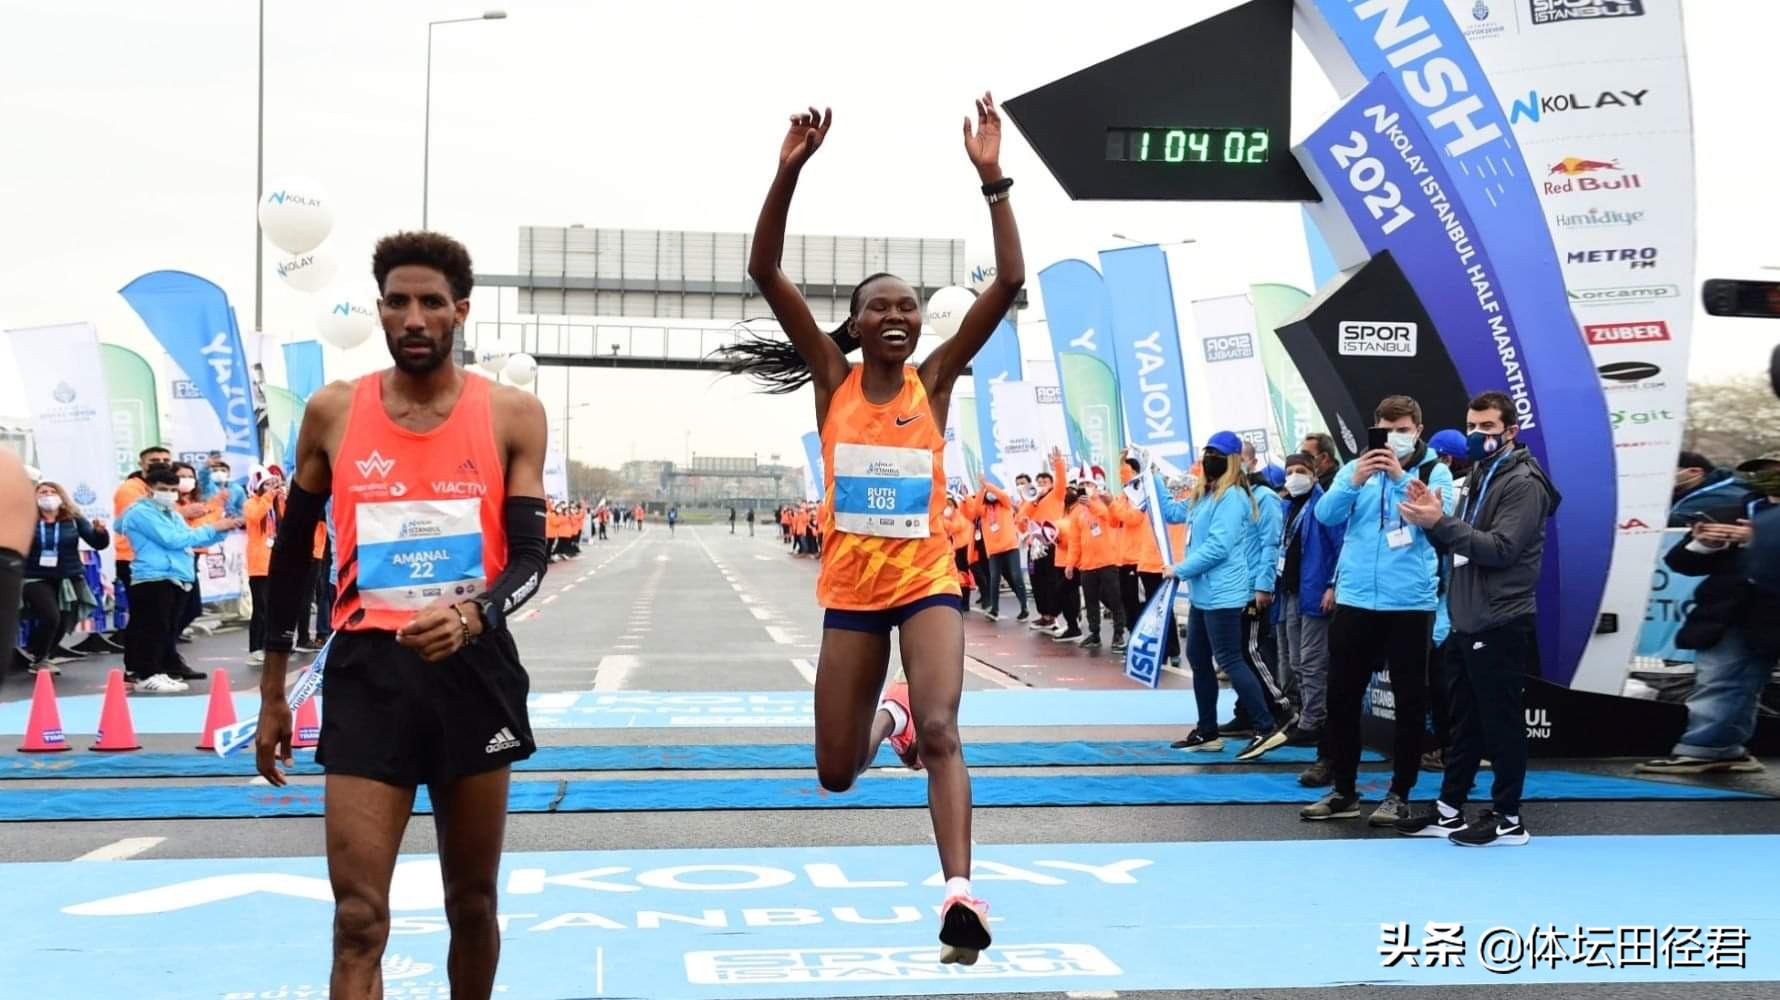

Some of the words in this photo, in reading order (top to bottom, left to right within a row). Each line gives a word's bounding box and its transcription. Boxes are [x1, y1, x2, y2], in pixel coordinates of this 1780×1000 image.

[1347, 0, 1502, 158] NISH
[1164, 130, 1209, 162] 04
[1223, 131, 1269, 163] 02
[1329, 130, 1416, 236] 2021
[1543, 179, 1573, 196] Red
[1577, 174, 1642, 192] Bull
[1567, 247, 1658, 264] METRO
[1629, 260, 1657, 270] FM
[1419, 175, 1476, 266] ISTANBUL
[1467, 263, 1501, 314] HALF
[1488, 315, 1537, 431] MARATHON
[1344, 325, 1411, 342] SPOR
[1590, 324, 1664, 343] ZUBER
[431, 481, 488, 495] VIACTIV
[867, 487, 897, 498] RUTH
[867, 497, 896, 510] 103
[392, 548, 451, 566] AMANAL
[409, 562, 435, 579] 22
[485, 740, 521, 755] adidas
[386, 905, 1004, 935] STANBU
